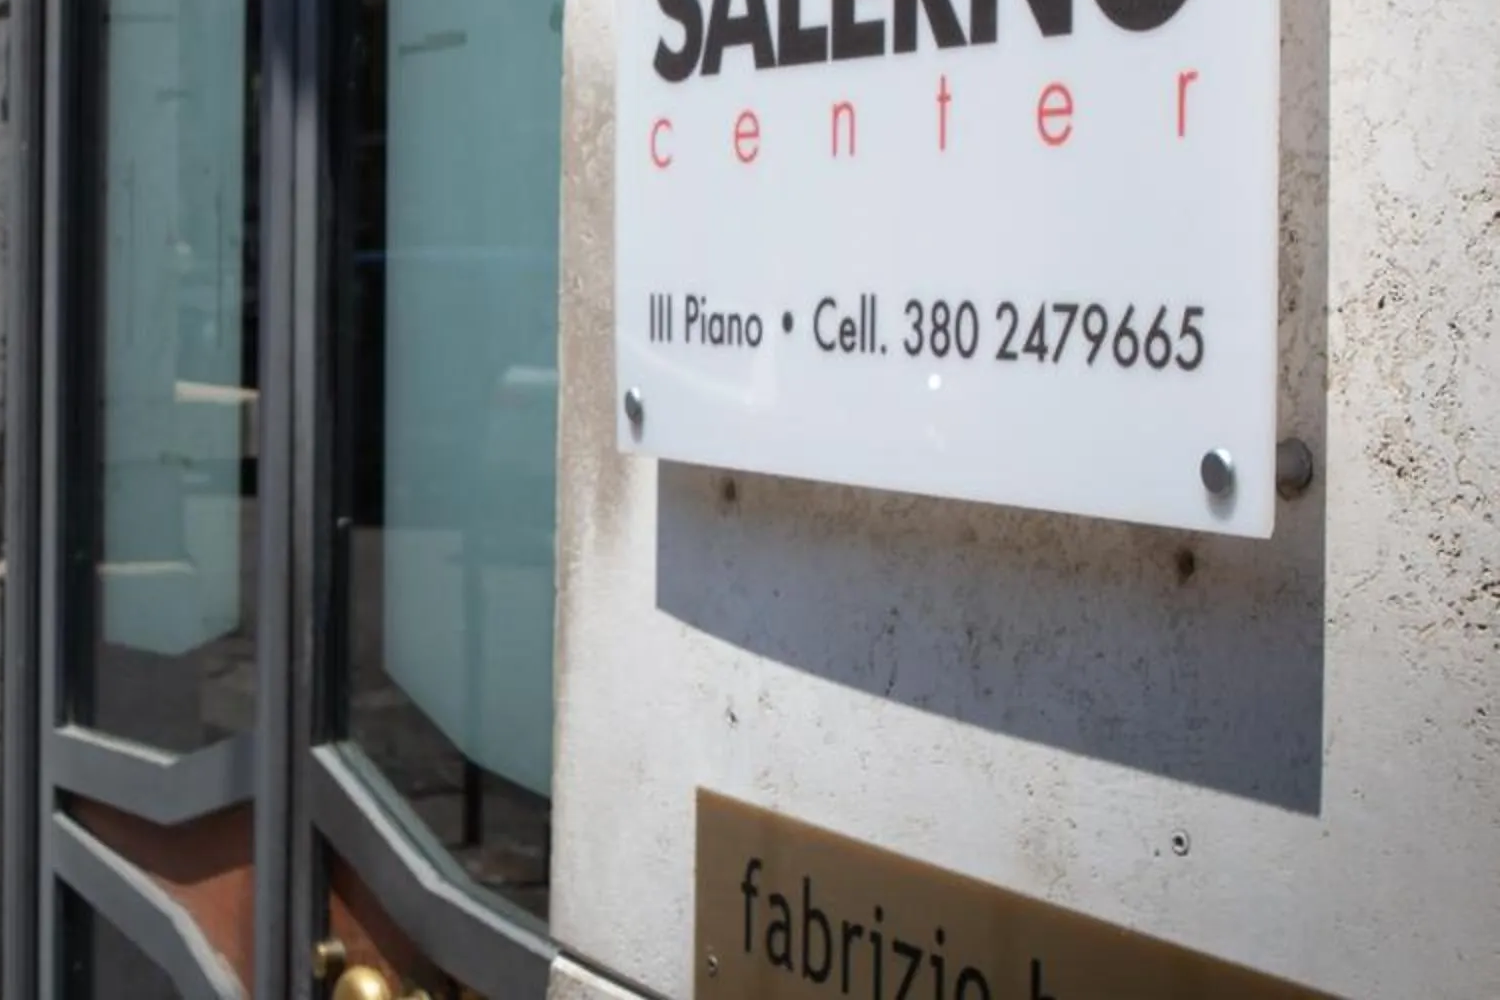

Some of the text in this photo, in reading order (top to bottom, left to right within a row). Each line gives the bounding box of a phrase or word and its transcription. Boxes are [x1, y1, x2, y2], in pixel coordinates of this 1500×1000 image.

[649, 69, 1199, 170] center
[648, 292, 1206, 372] III Piano Cell. 380 2479665
